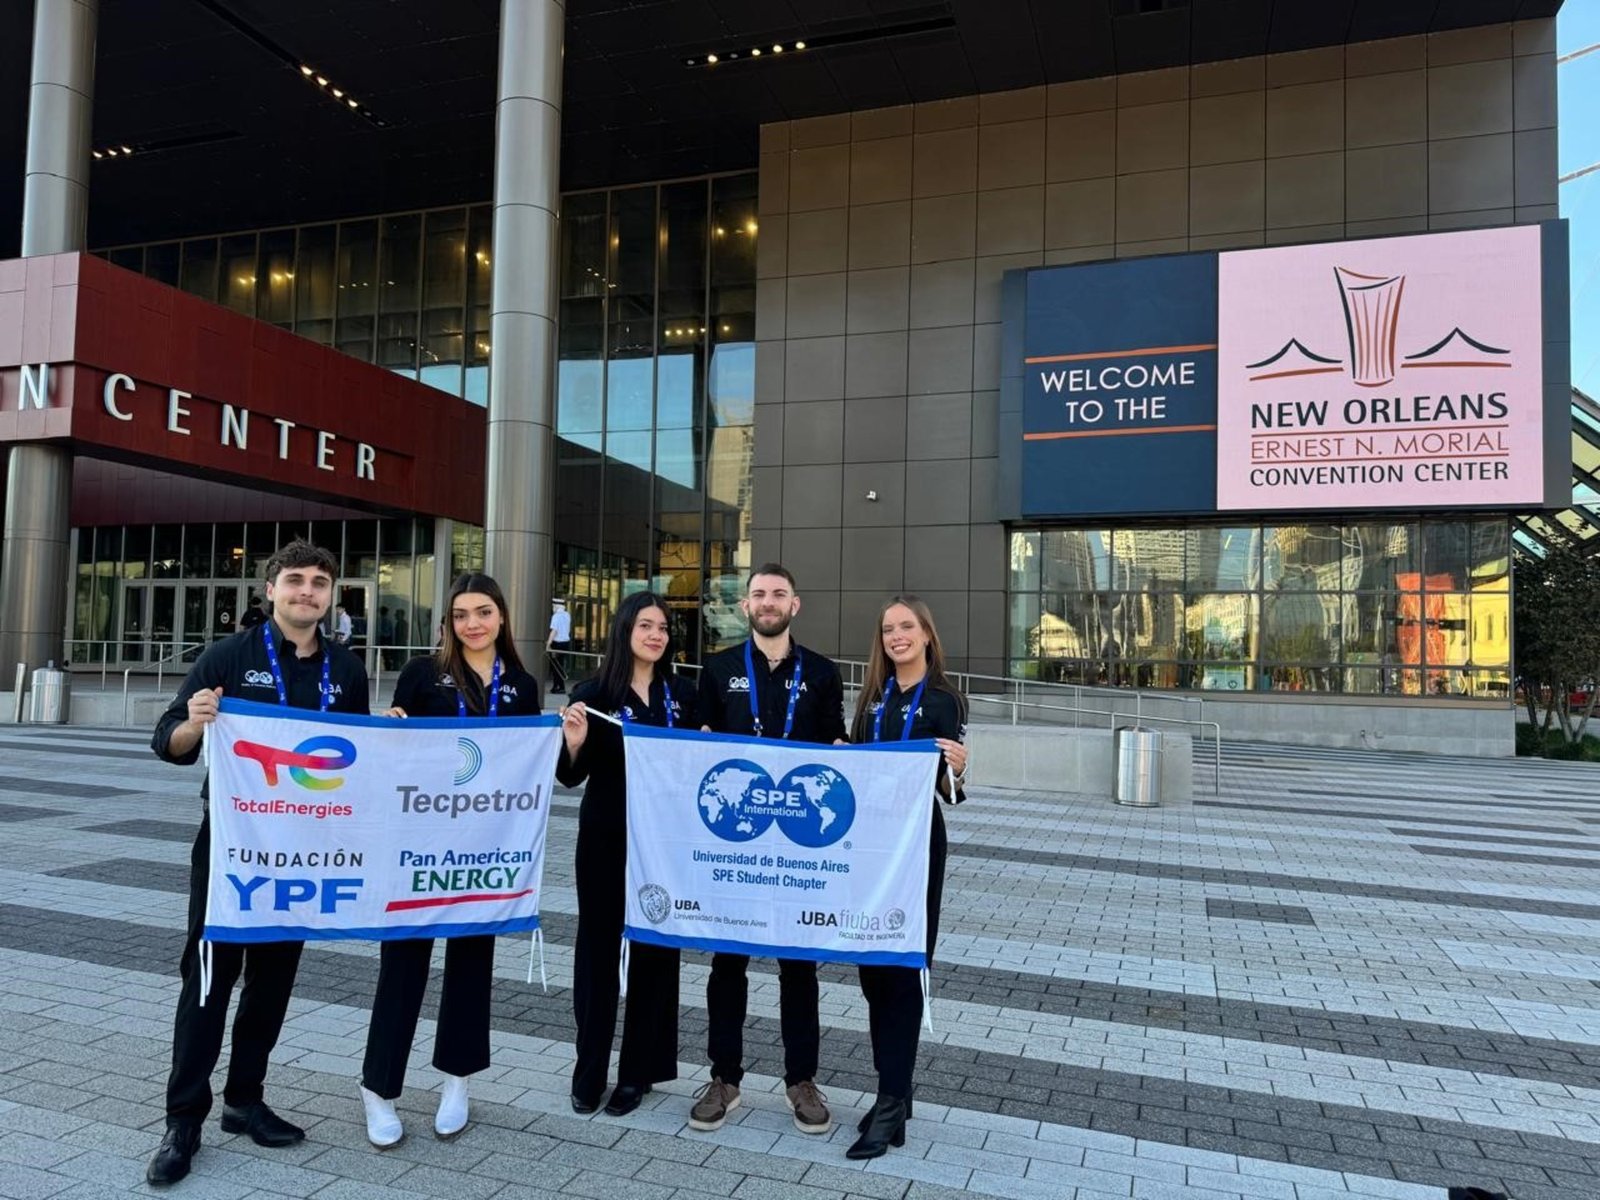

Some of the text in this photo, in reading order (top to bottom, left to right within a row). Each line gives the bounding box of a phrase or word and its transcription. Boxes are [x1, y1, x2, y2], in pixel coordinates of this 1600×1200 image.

[1041, 362, 1195, 393] WELCOME
[1066, 397, 1167, 424] TO THE
[1251, 392, 1509, 429] NEW ORLEANS
[104, 373, 376, 481] CENTER
[1251, 432, 1510, 460] ERNEST N. MORIAL
[1250, 461, 1510, 487] CONVENTION CENTER
[785, 680, 808, 692] UA
[901, 704, 923, 717] UA
[231, 796, 353, 819] TotalEnergies
[396, 784, 541, 819] Tecpetrol
[751, 788, 802, 807] SPE
[744, 804, 807, 818] International
[228, 848, 364, 868] FUNDACIÓN
[400, 846, 533, 867] Pan American
[693, 850, 850, 873] Universidad de Buenos Aires
[412, 867, 521, 892] ENERGY
[713, 869, 827, 891] SPE Student Chapter
[225, 874, 364, 914] YPF
[674, 899, 701, 911] UBA
[673, 913, 713, 922] Universidad
[723, 917, 749, 926] Buenos
[750, 919, 768, 928] Aires
[839, 931, 866, 941] FACULTAD
